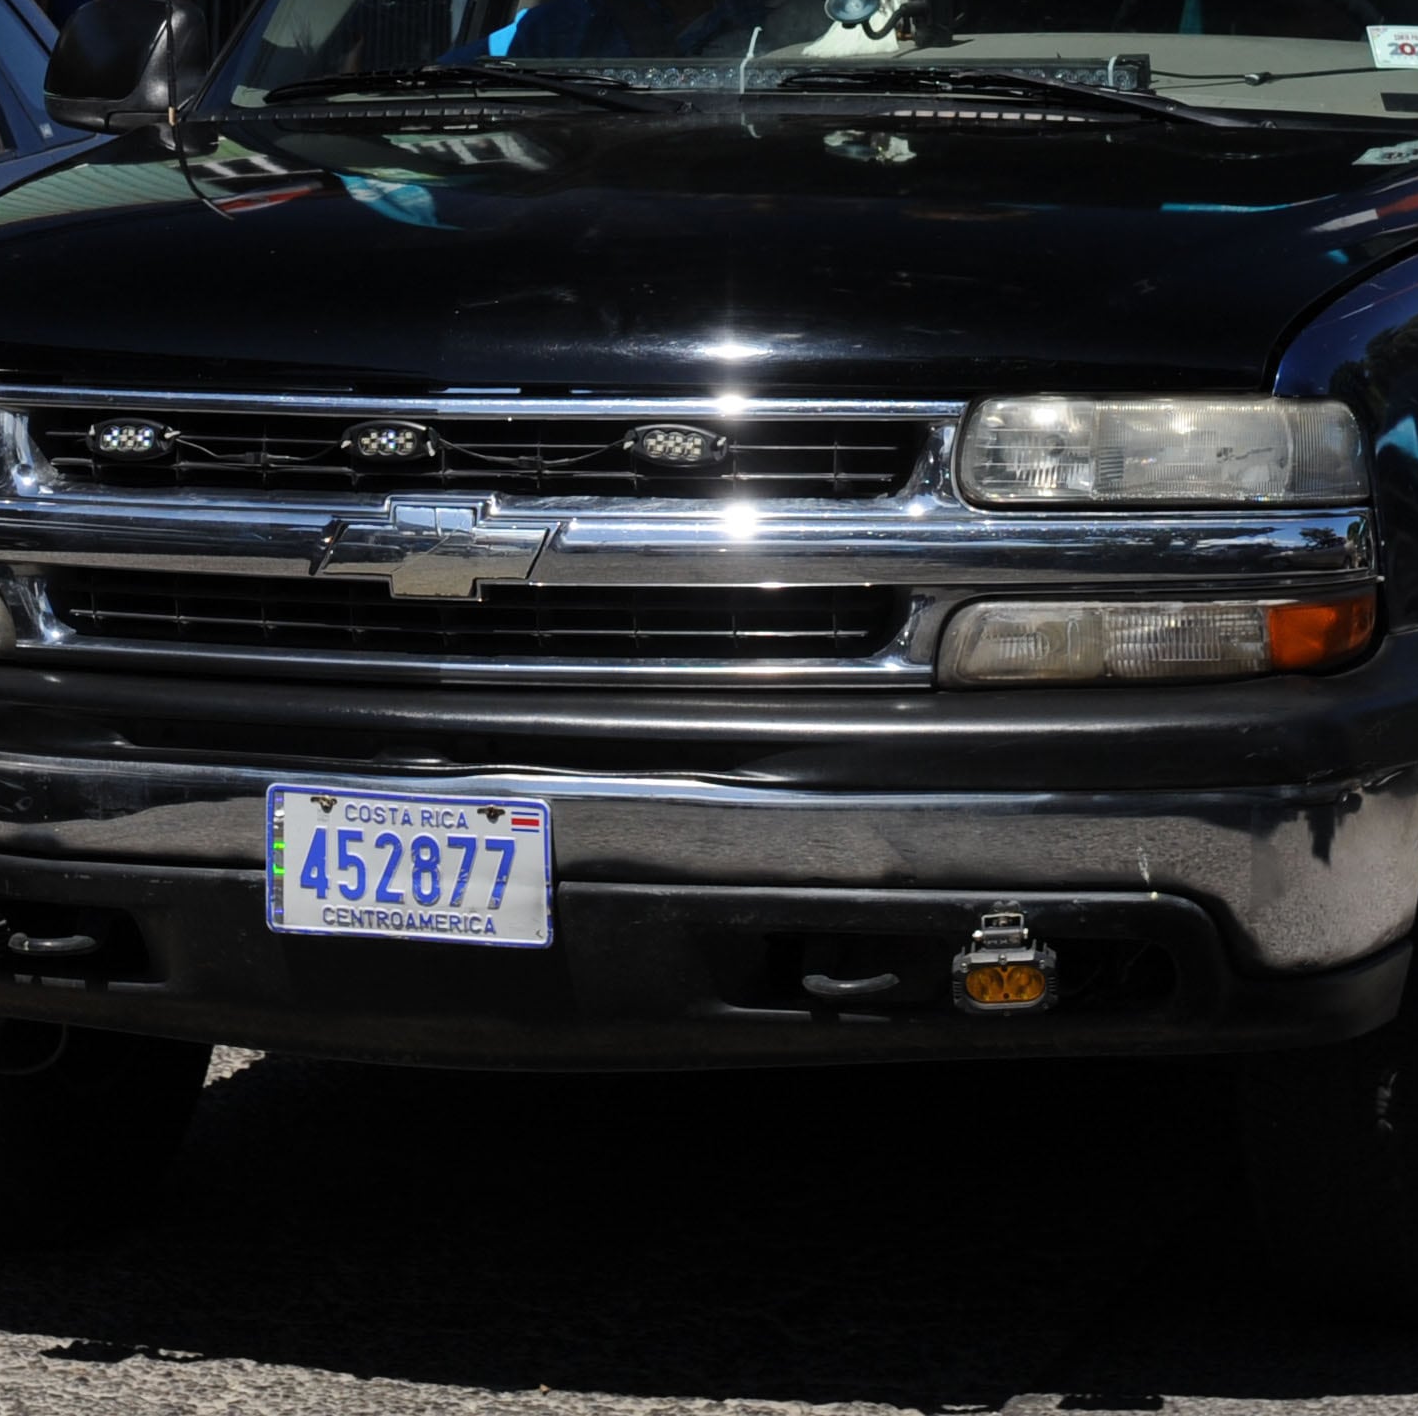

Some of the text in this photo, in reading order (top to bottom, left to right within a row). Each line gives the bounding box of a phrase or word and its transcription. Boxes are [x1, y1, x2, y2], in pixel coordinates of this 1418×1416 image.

[344, 803, 470, 830] COSTA RICA
[299, 827, 517, 910] 452877
[322, 905, 497, 935] CENTROAMERICA
